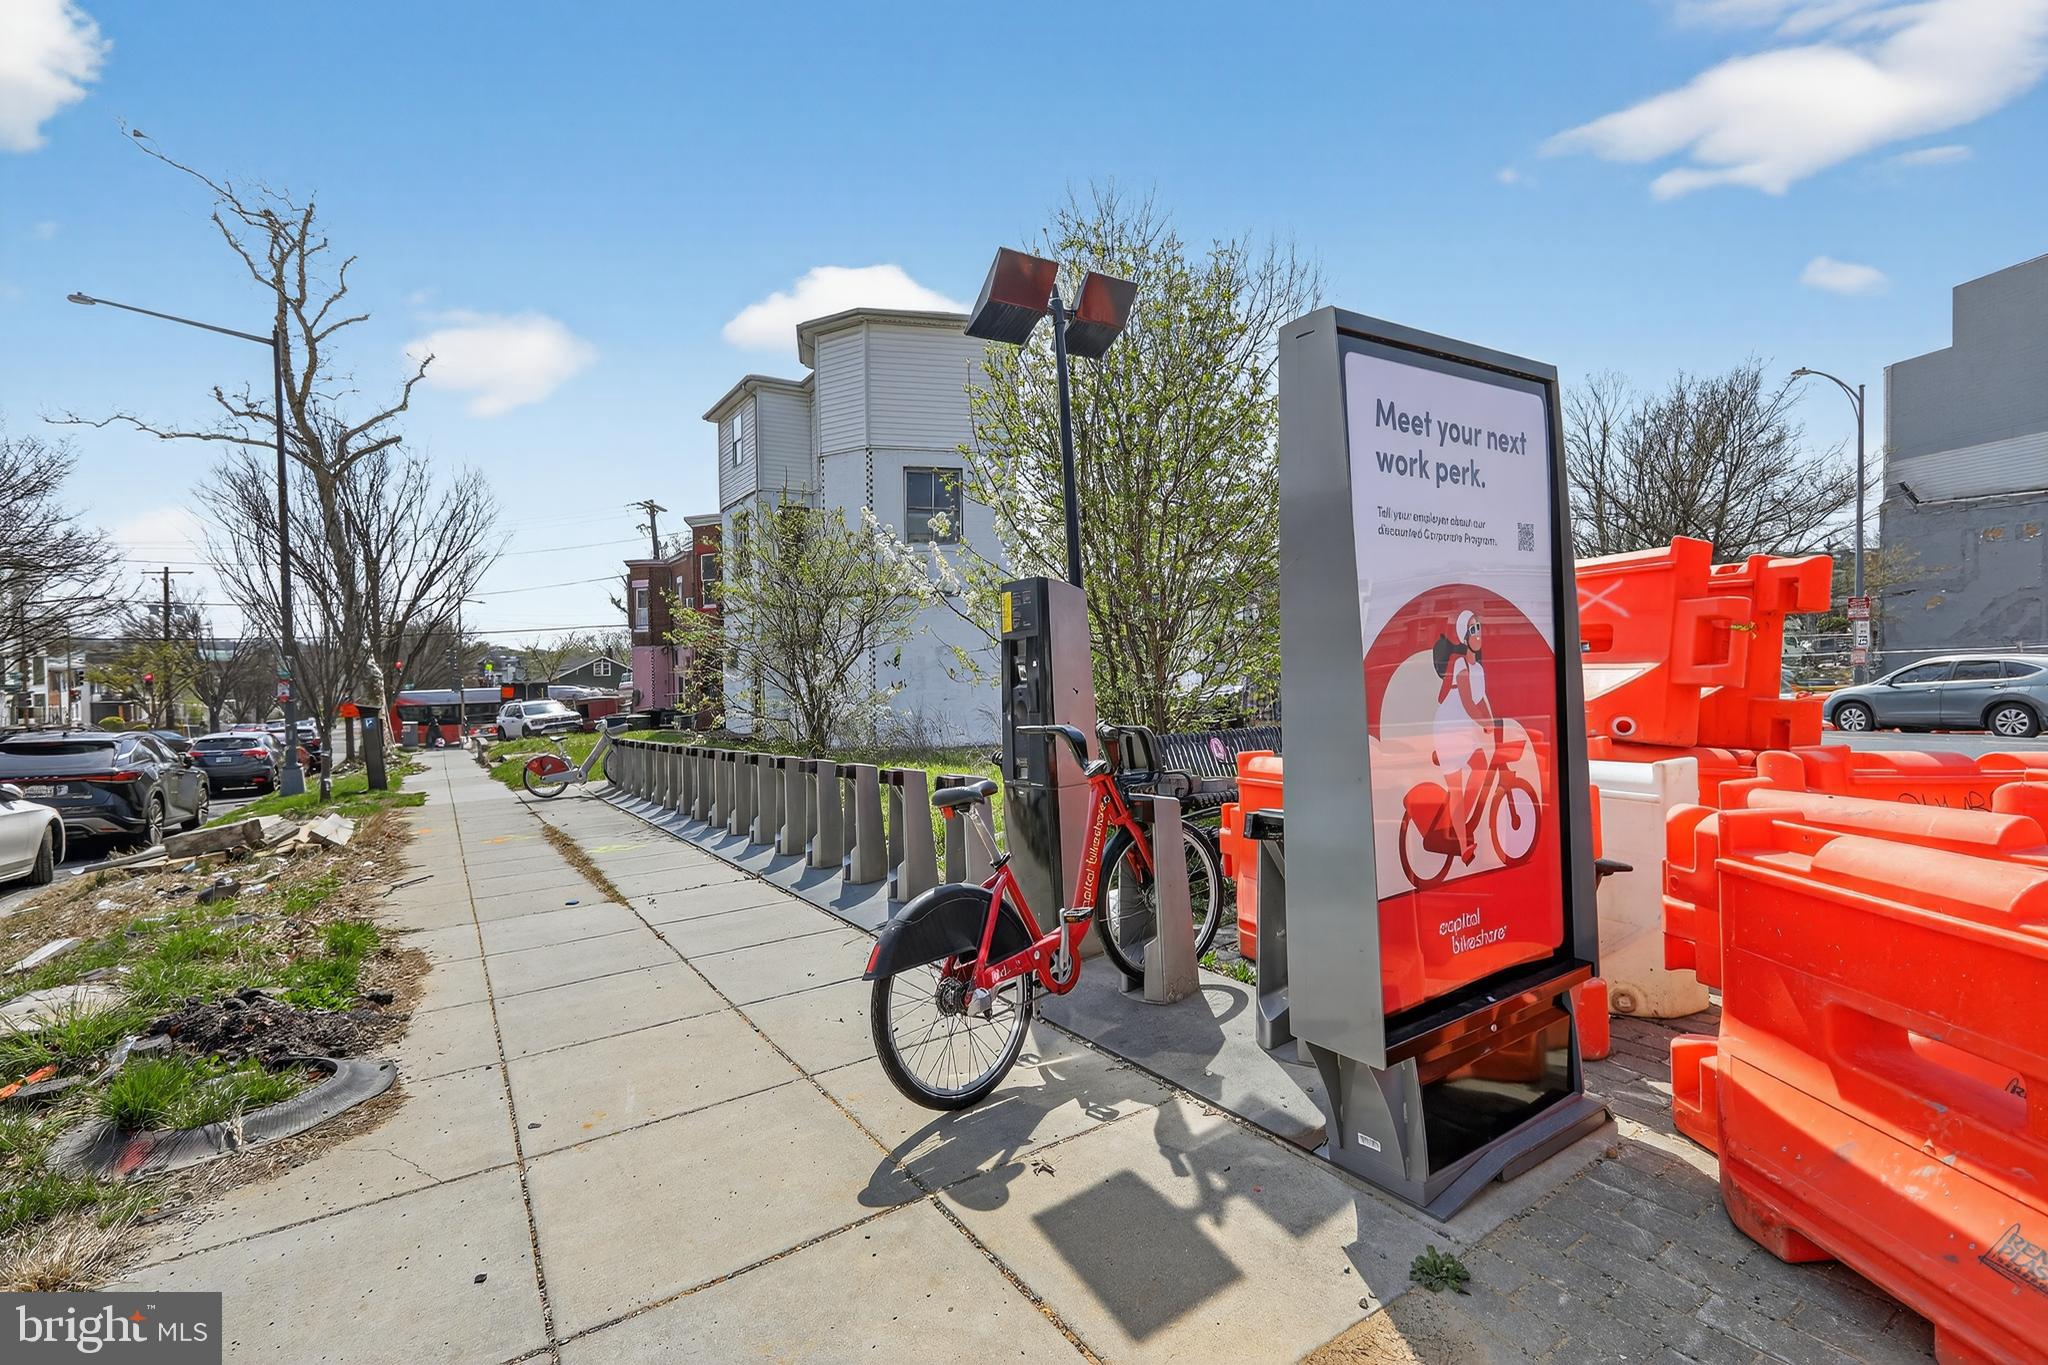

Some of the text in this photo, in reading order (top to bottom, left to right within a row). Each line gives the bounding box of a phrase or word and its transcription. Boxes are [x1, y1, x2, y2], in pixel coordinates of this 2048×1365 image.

[1375, 398, 1527, 455] Meet your next
[1375, 449, 1486, 488] work perk.
[1439, 907, 1480, 936] capital
